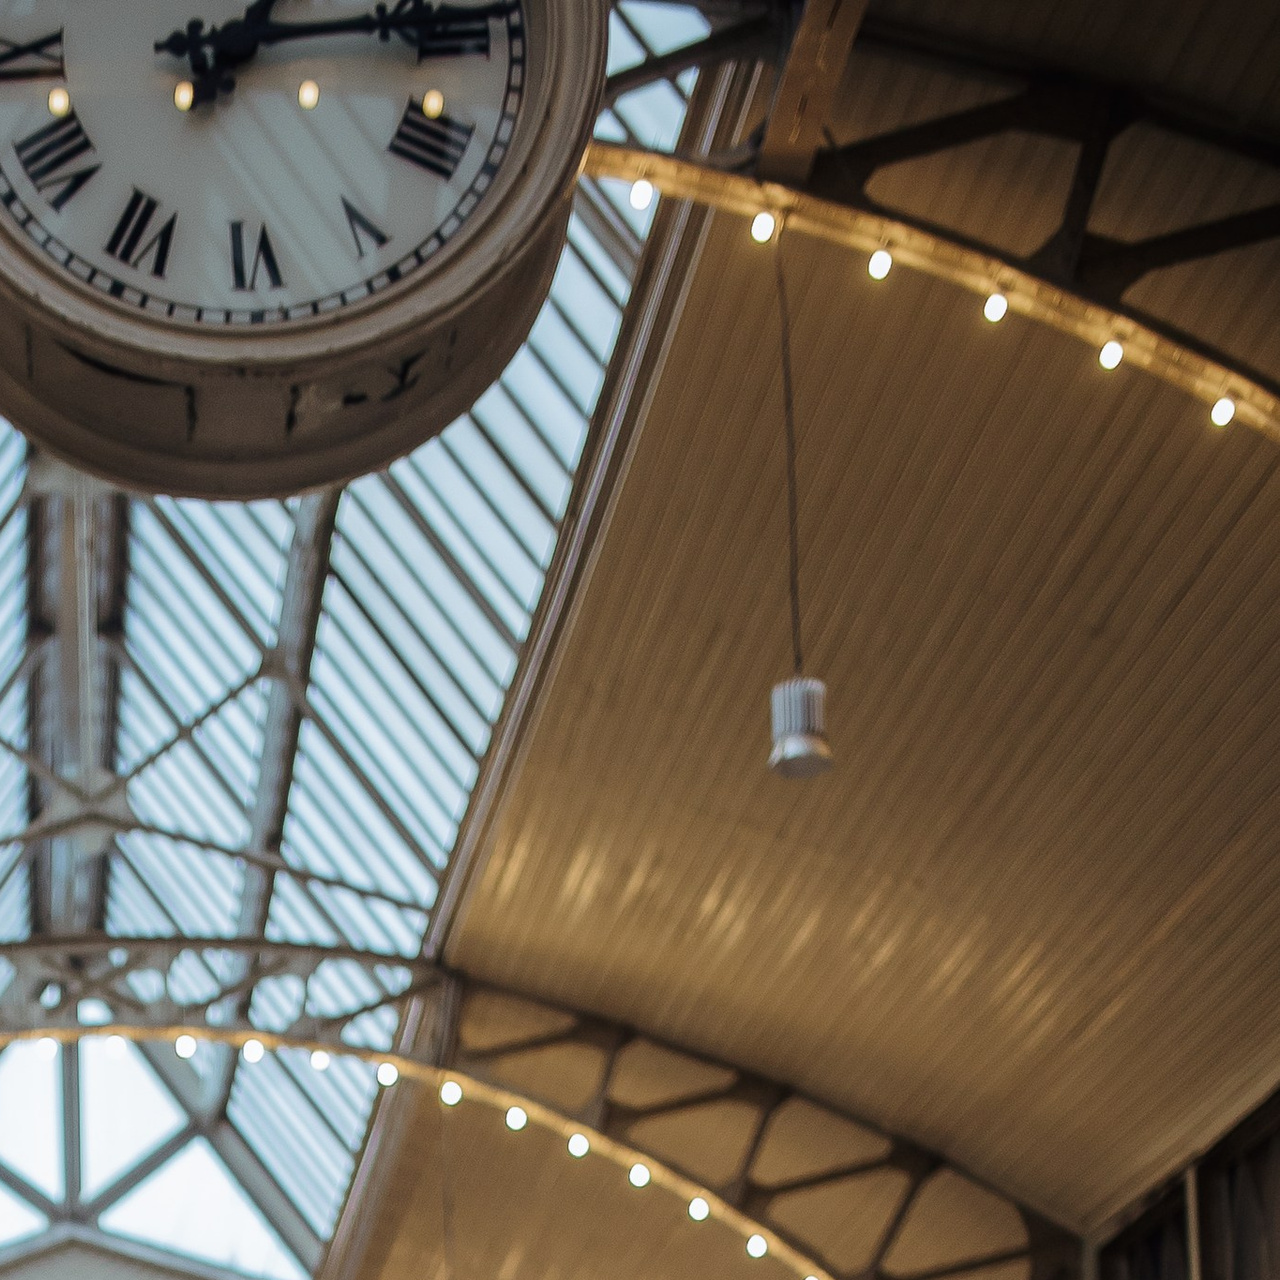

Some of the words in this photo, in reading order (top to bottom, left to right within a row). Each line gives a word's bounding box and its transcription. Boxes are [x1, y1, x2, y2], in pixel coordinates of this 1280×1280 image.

[417, 14, 490, 62] II
[12, 105, 102, 214] VIII
[387, 95, 476, 182] IIII
[104, 183, 178, 281] VII
[228, 219, 286, 292] VI
[340, 193, 391, 262] V
